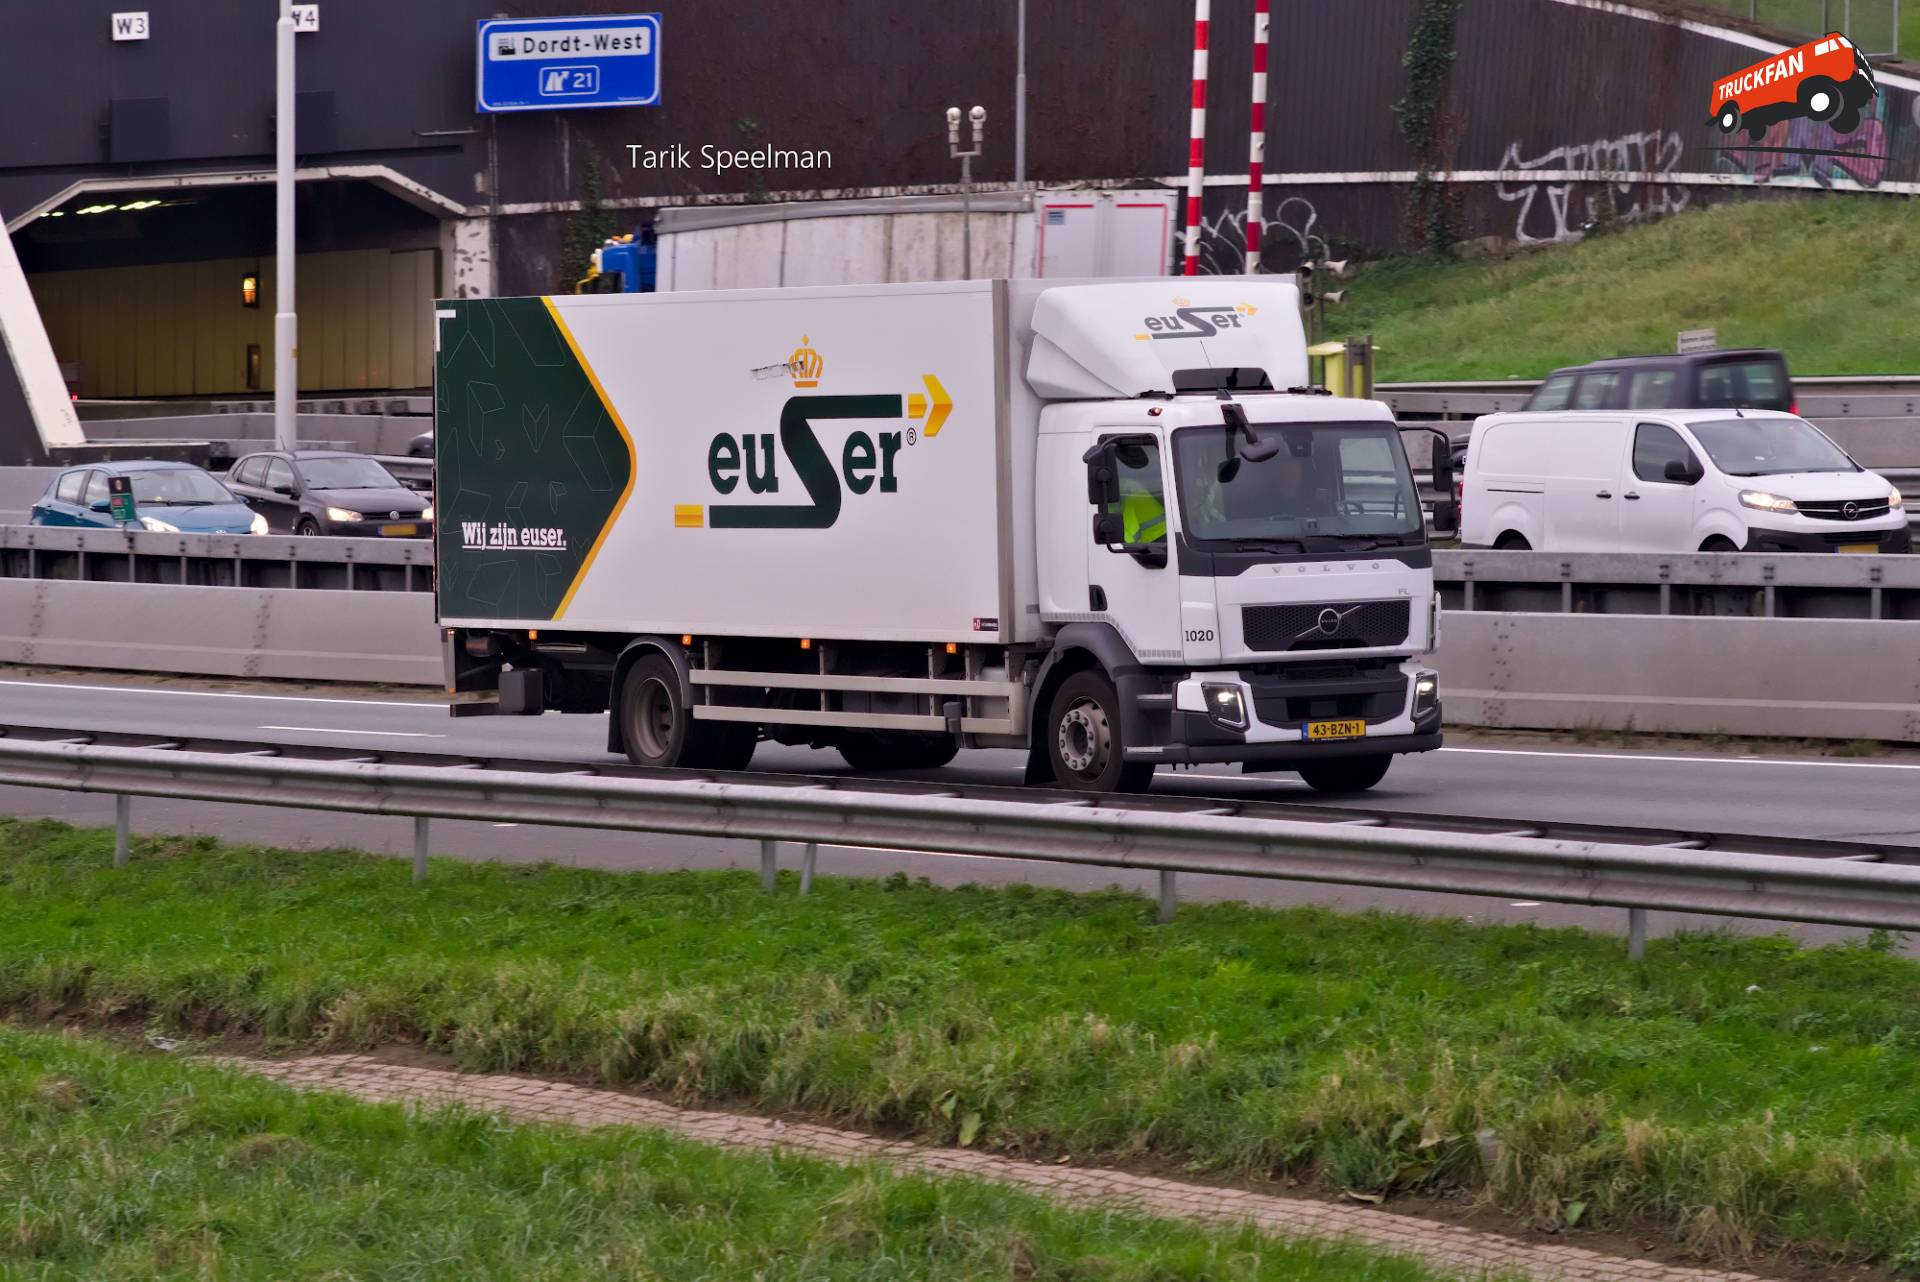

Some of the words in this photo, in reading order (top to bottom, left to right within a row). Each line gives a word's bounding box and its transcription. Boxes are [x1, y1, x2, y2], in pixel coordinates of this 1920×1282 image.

[523, 33, 643, 53] Dordt-West
[573, 73, 592, 88] 21
[462, 522, 486, 550] Wij
[489, 522, 518, 550] zijn
[520, 527, 567, 546] euser.
[1272, 562, 1381, 574] VOLVO
[1185, 630, 1214, 642] 1020
[1313, 722, 1360, 736] 43-BZN-1
